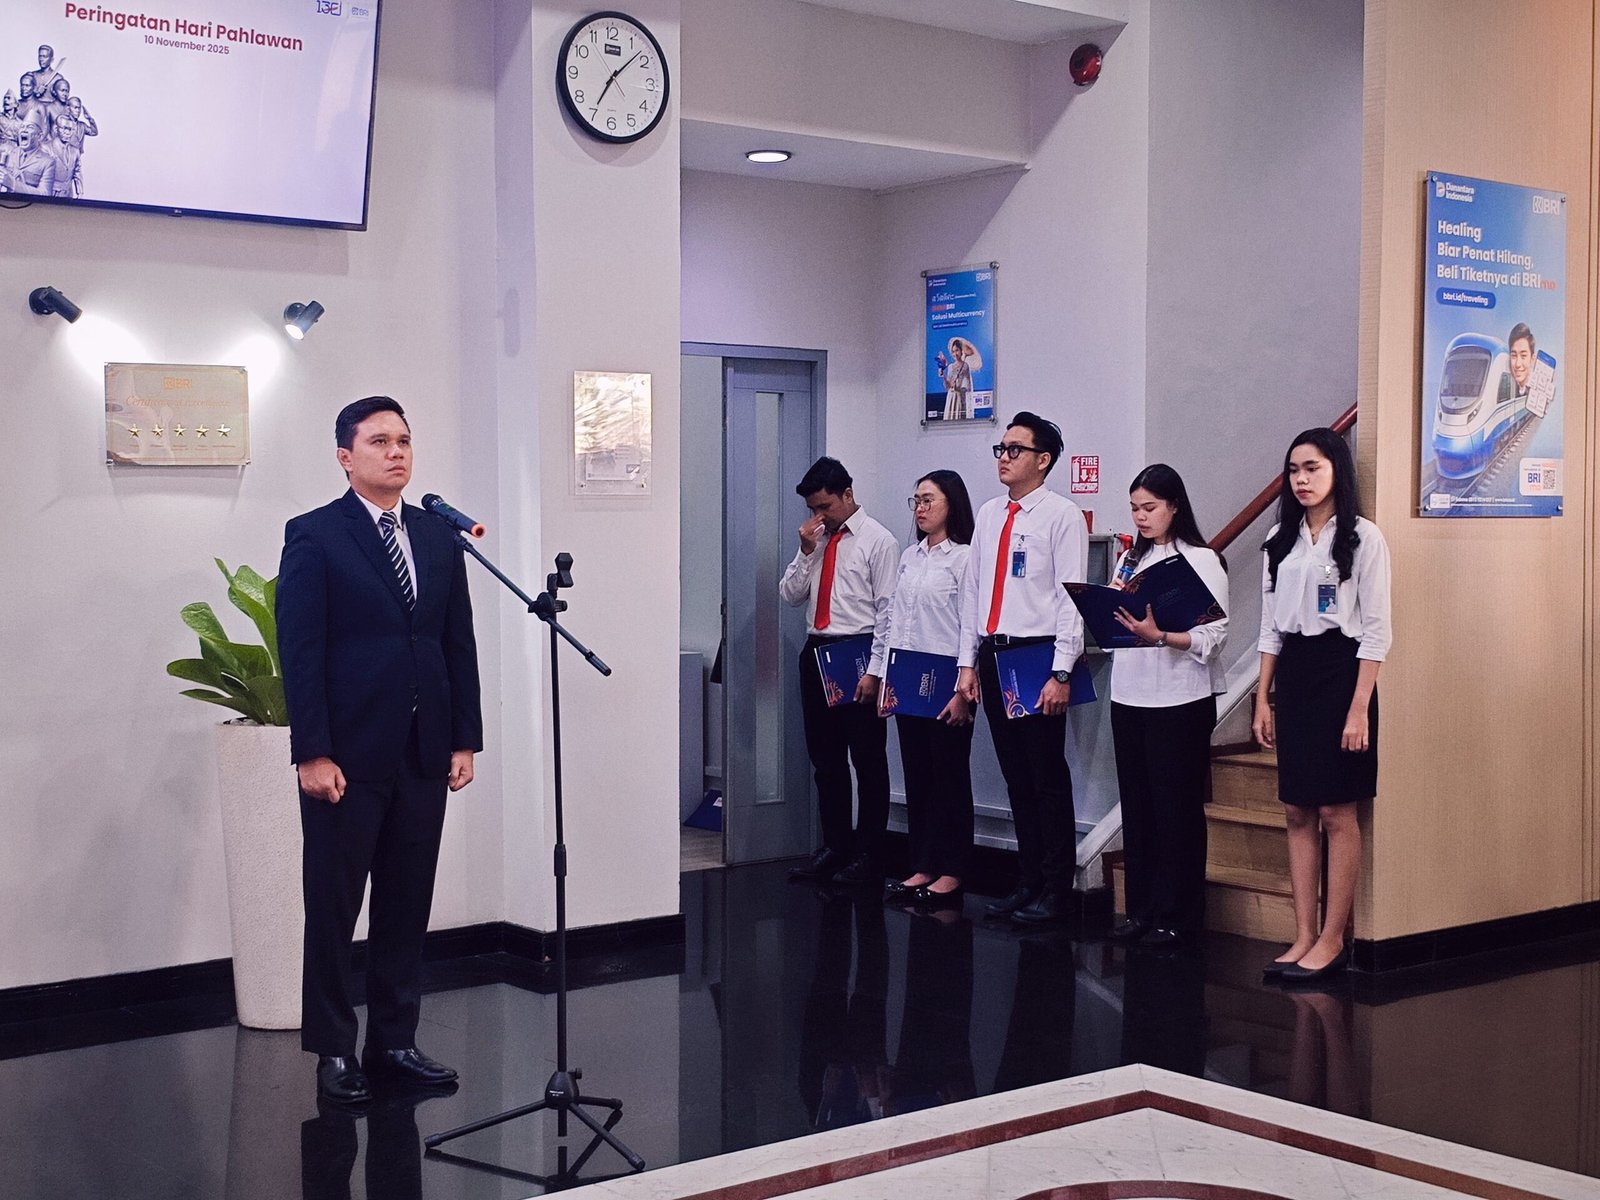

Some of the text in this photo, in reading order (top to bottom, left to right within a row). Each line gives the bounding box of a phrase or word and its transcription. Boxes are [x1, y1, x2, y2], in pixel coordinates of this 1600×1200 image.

[65, 3, 303, 51] Peringatan Hari Pahlawan
[606, 26, 619, 41] 12
[590, 29, 598, 44] 11
[144, 34, 230, 55] 10 November 2025
[575, 44, 589, 59] 10
[639, 55, 650, 69] 2
[568, 65, 579, 79] 9
[645, 77, 656, 92] 3
[574, 89, 585, 103] 8
[639, 99, 648, 113] 4
[588, 107, 598, 121] 7
[626, 113, 637, 127] 5
[606, 116, 617, 130] 6
[1446, 182, 1475, 194] Danantara
[1543, 198, 1560, 215] BRI
[1437, 220, 1482, 242] Healing
[1437, 242, 1534, 270] Biar Penat Hilang,
[1437, 264, 1458, 279] Beli
[1460, 266, 1508, 288] Tiketnya
[1509, 271, 1521, 286] di
[1080, 457, 1098, 466] FIRE
[1527, 472, 1541, 483] BRI
